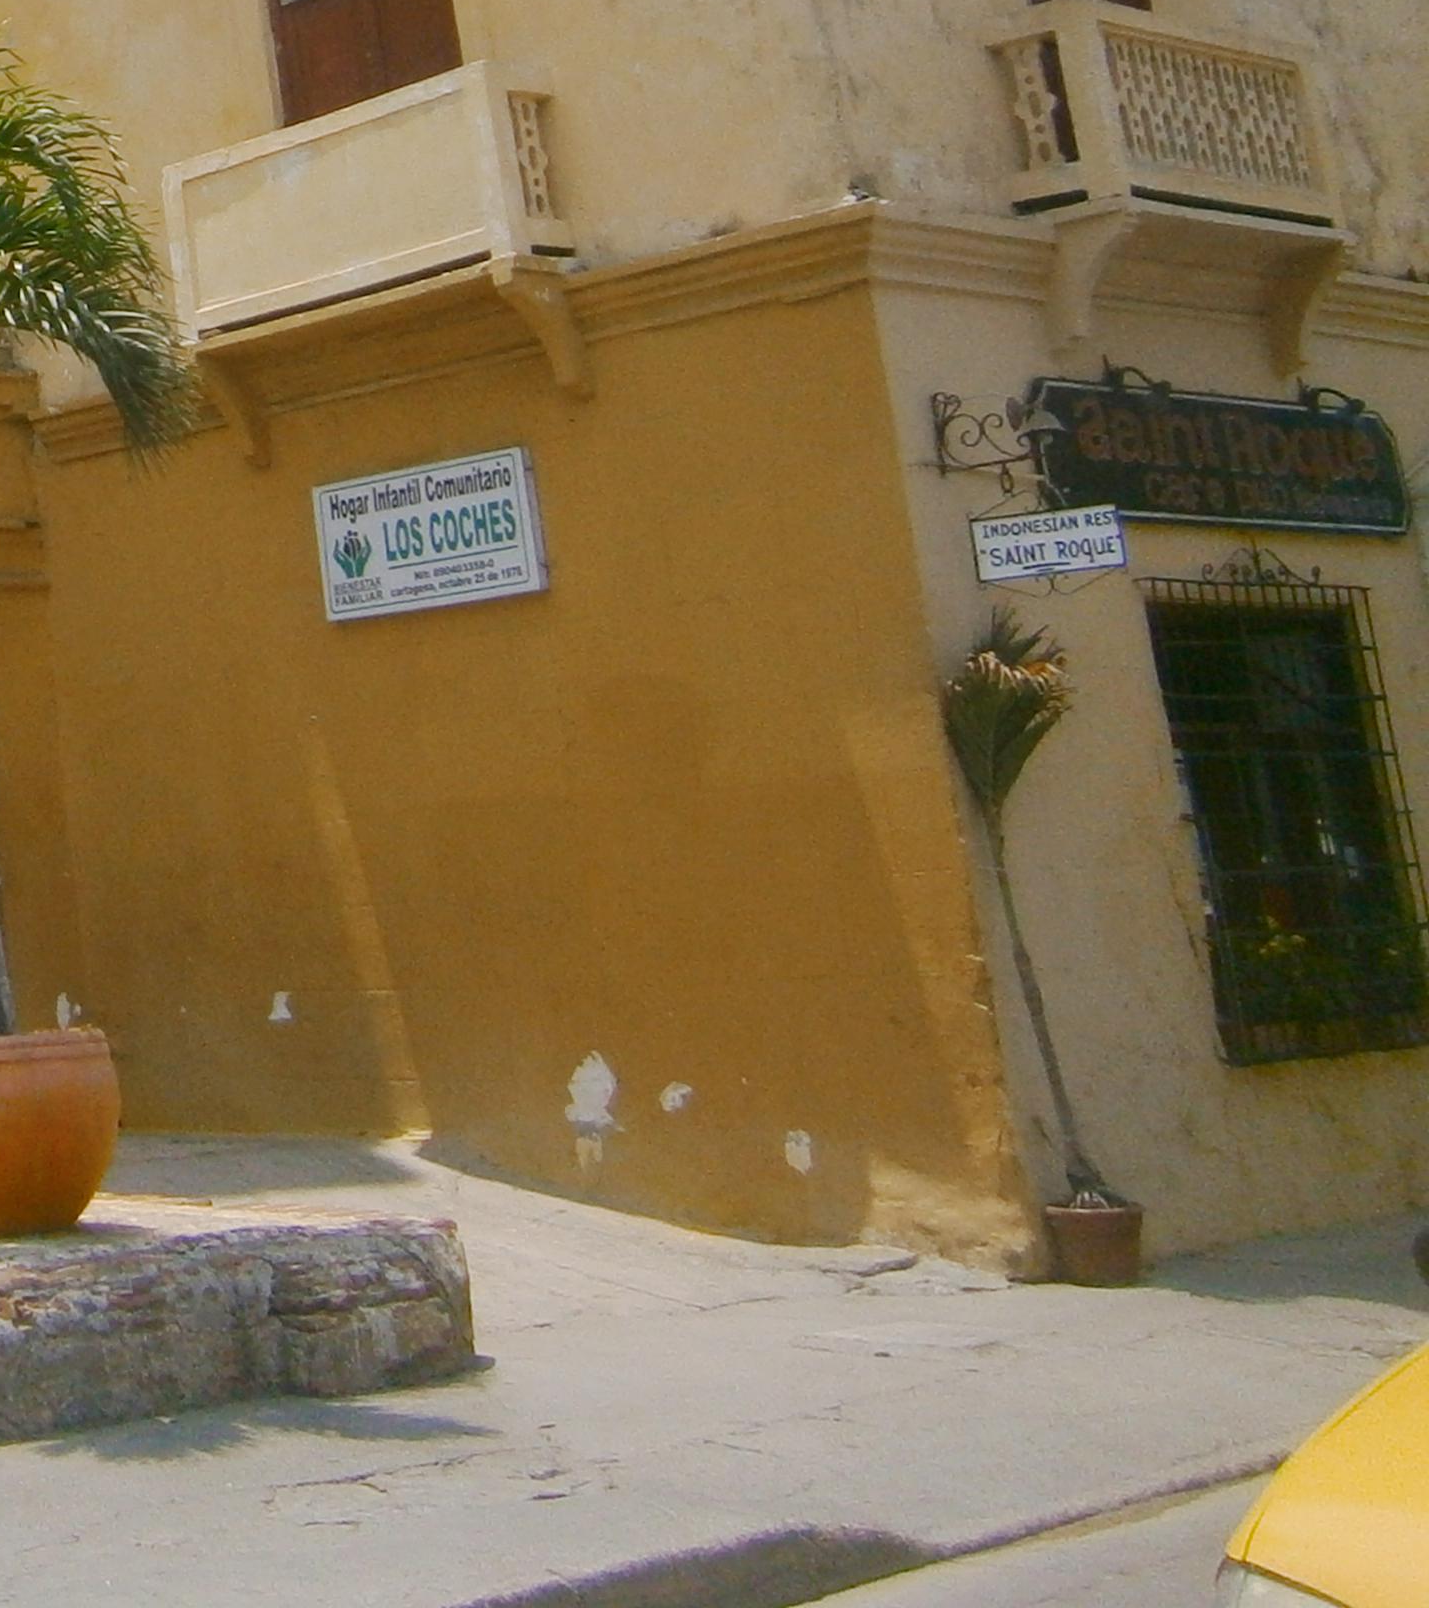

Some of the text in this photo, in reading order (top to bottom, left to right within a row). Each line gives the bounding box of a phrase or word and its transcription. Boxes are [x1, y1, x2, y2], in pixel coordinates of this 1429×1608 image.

[329, 461, 512, 524] Hogar Infantil Comunitario
[383, 499, 516, 562] LOS COCHES
[982, 515, 1079, 539] INDONESIAN
[335, 590, 384, 607] FAMILIAR
